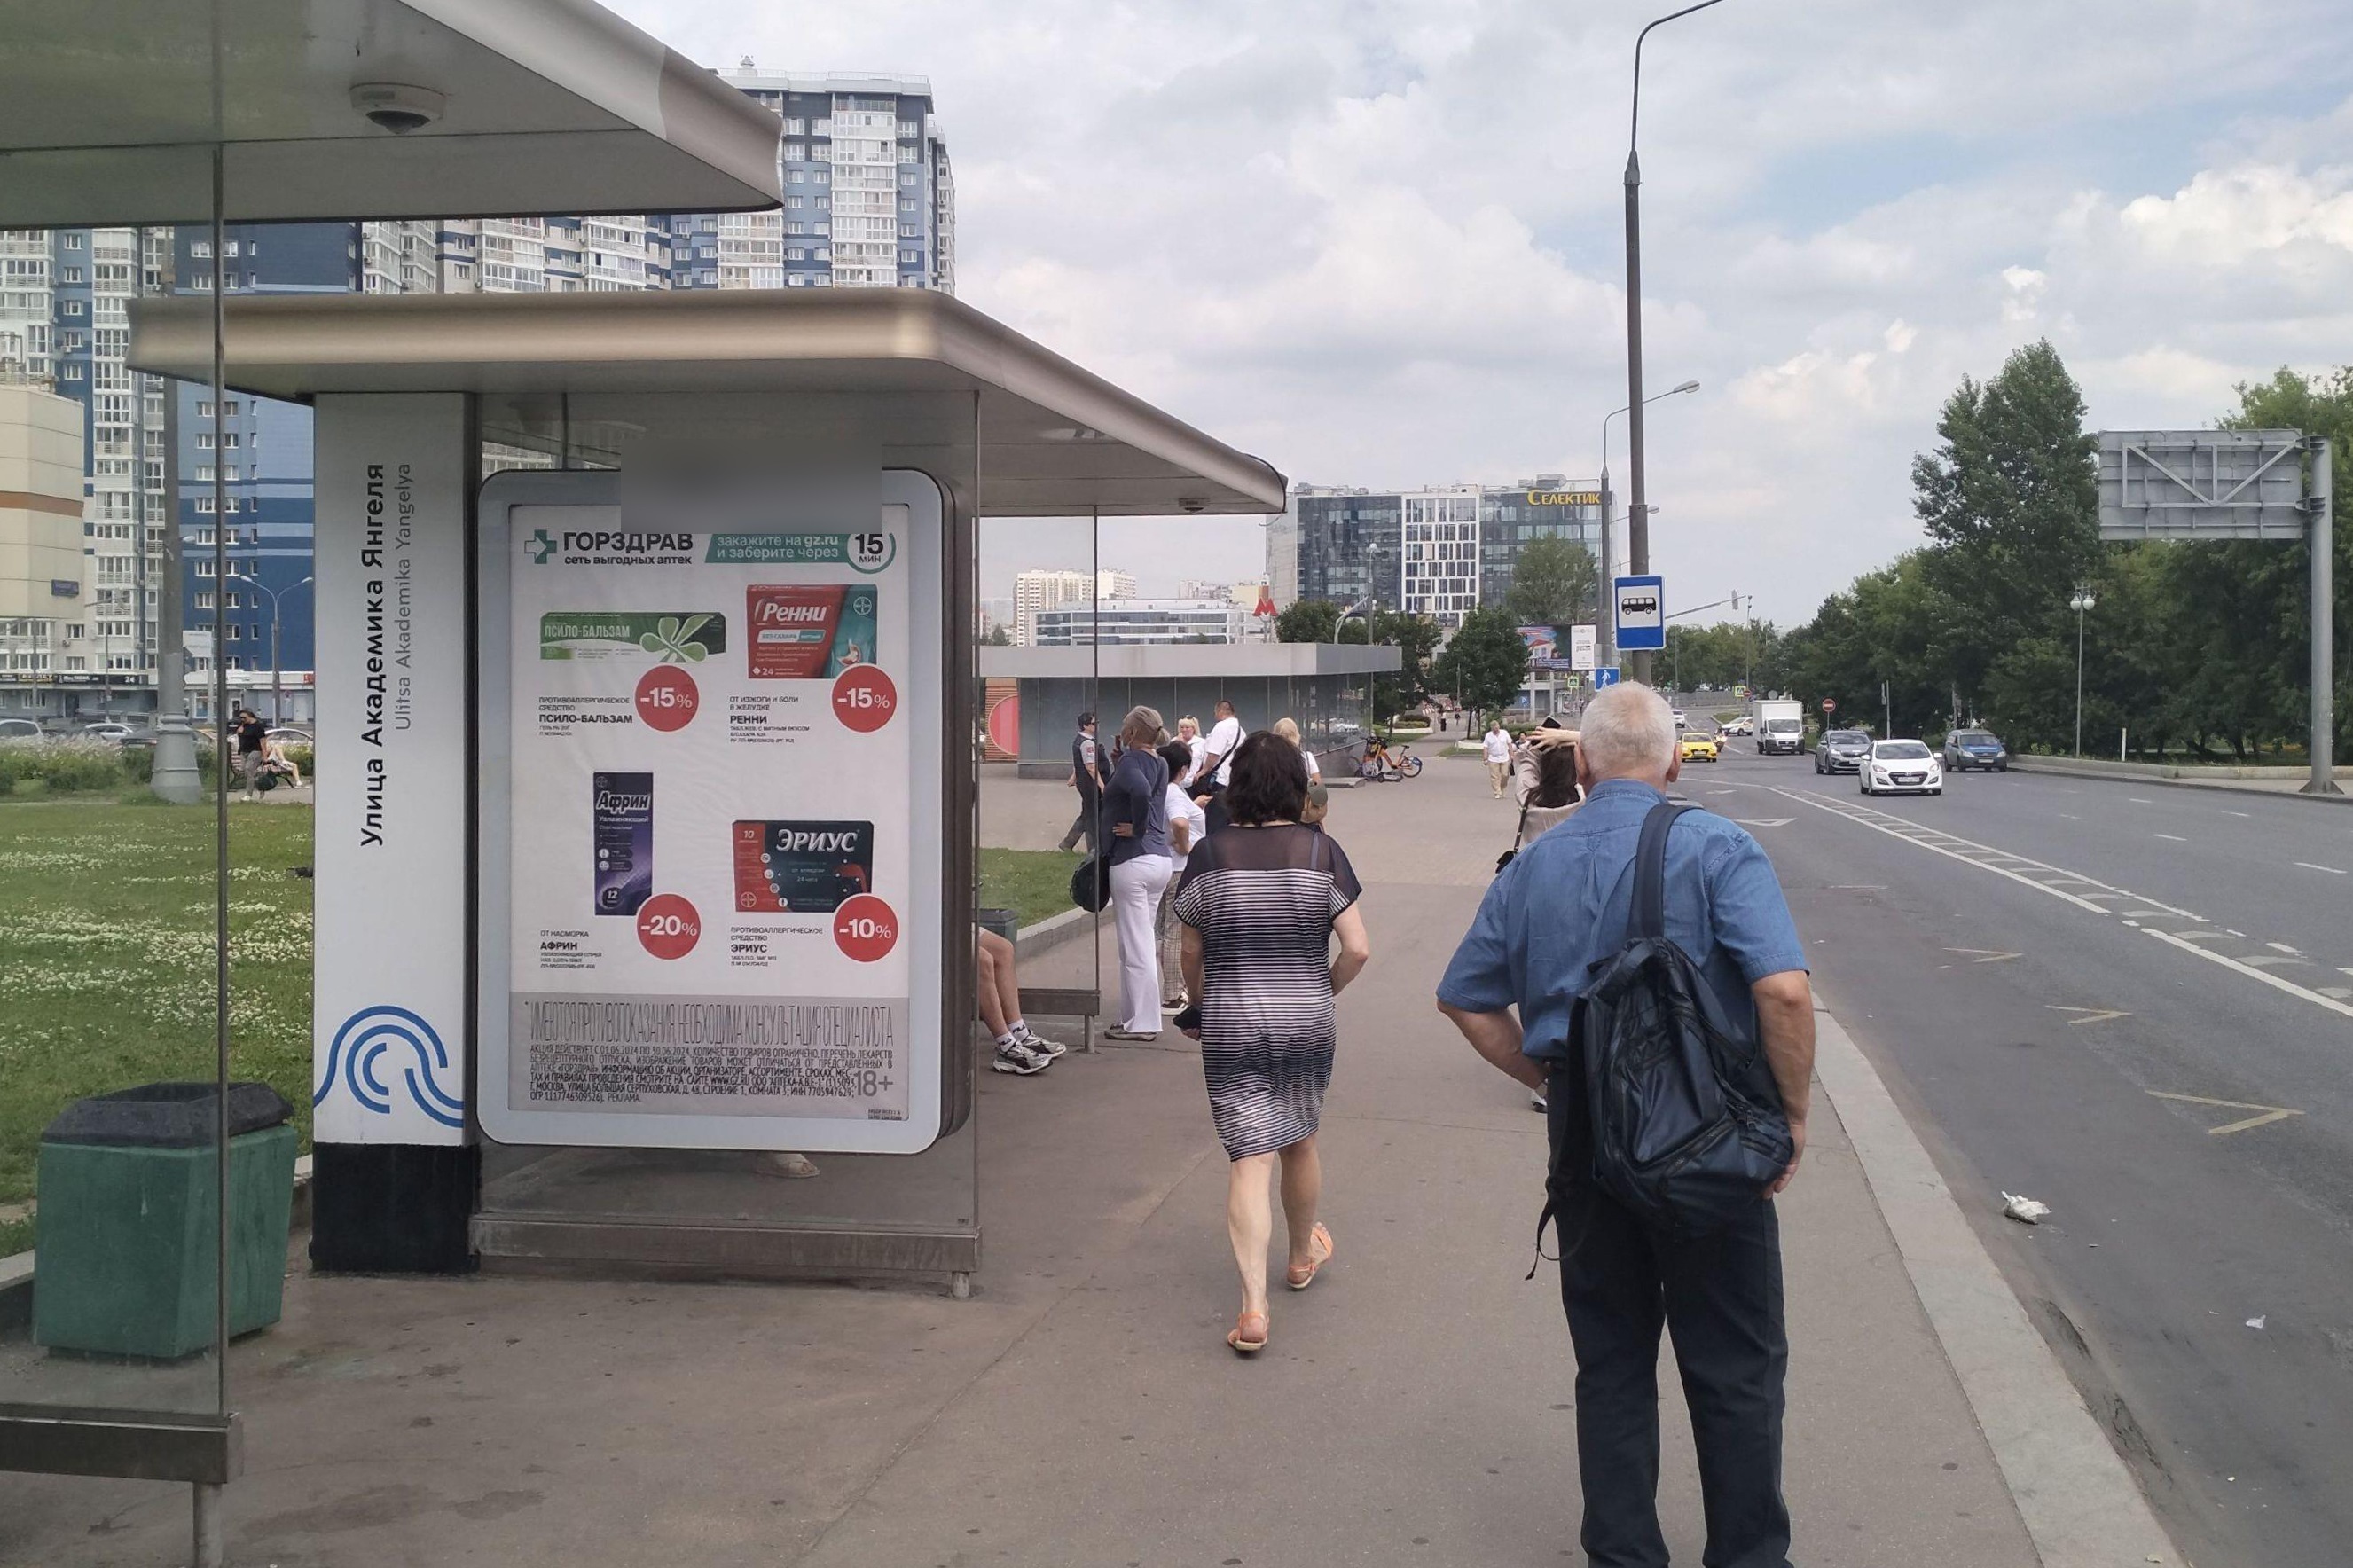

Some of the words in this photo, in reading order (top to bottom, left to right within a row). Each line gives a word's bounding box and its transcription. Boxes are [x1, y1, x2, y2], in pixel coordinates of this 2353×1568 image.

[1527, 489, 1610, 506] СЕЛЕКТИК
[360, 464, 384, 568] Янгеля
[394, 464, 415, 550] Yangelya
[563, 532, 694, 554] ГОРЗДРАВ
[717, 535, 782, 546] закажите
[785, 536, 801, 545] на
[804, 535, 838, 548] gz.ru
[855, 533, 884, 554] 15
[593, 556, 654, 566] выгодных
[657, 555, 692, 565] аптек
[717, 549, 726, 558] и
[729, 546, 796, 560] заберите
[797, 548, 838, 561] через
[394, 558, 412, 668] Akademika
[762, 602, 827, 622] Ренни
[544, 624, 631, 638] ПСИЛО-БАЛЬЗАМ
[360, 579, 387, 747] Академика
[762, 667, 774, 676] 24
[394, 676, 412, 731] Ulitsa
[639, 687, 693, 709] -15%
[836, 687, 890, 709] -15%
[538, 714, 633, 724] ПСИЛО-БАЛЬЗАМ
[730, 715, 767, 725] РЕННИ
[360, 758, 387, 847] Улица
[595, 790, 651, 815] Африн
[743, 830, 755, 839] 10
[776, 828, 859, 853] ЭРИУС
[607, 890, 618, 899] 12
[640, 915, 697, 937] -20%
[839, 918, 892, 939] -10%
[540, 941, 578, 951] АФРИН
[730, 944, 768, 953] ЭРИУС
[531, 1001, 576, 1042] ИМЕЮТСЯ
[678, 1003, 741, 1045] НЕОБХОДИМА
[745, 1004, 821, 1046] КОНСУЛЬТАЦИЯ
[823, 1005, 894, 1047] СПЕЦИАЛИСТА
[637, 1055, 686, 1065] ИЗОБРАЖЕНИЕ
[692, 1056, 721, 1065] ТОВАРОВ
[727, 1057, 751, 1066] МОЖЕТ
[757, 1057, 800, 1067] ОТЛИЧАТЬСЯ
[804, 1058, 813, 1067] ОТ
[819, 1058, 883, 1068] ПРЕДСТАВЛЕННЫХ
[693, 1047, 739, 1056] КОЛИЧЕСТВО
[741, 1048, 771, 1057] ТОВАРОВ
[820, 1049, 856, 1058] ПЕРЕЧЕНЬ
[858, 1050, 893, 1059] ЛЕКАРСТВ
[601, 1065, 654, 1074] ИНФОРМАЦИЮ
[637, 1075, 672, 1084] СМОТРИТЕ
[687, 1076, 709, 1085] САЙТЕ
[853, 1070, 894, 1097] 18+
[592, 1084, 625, 1093] БОЛЬШАЯ
[703, 1086, 740, 1094] СТРОЕНИЕ
[748, 1086, 780, 1095] КОМНАТА
